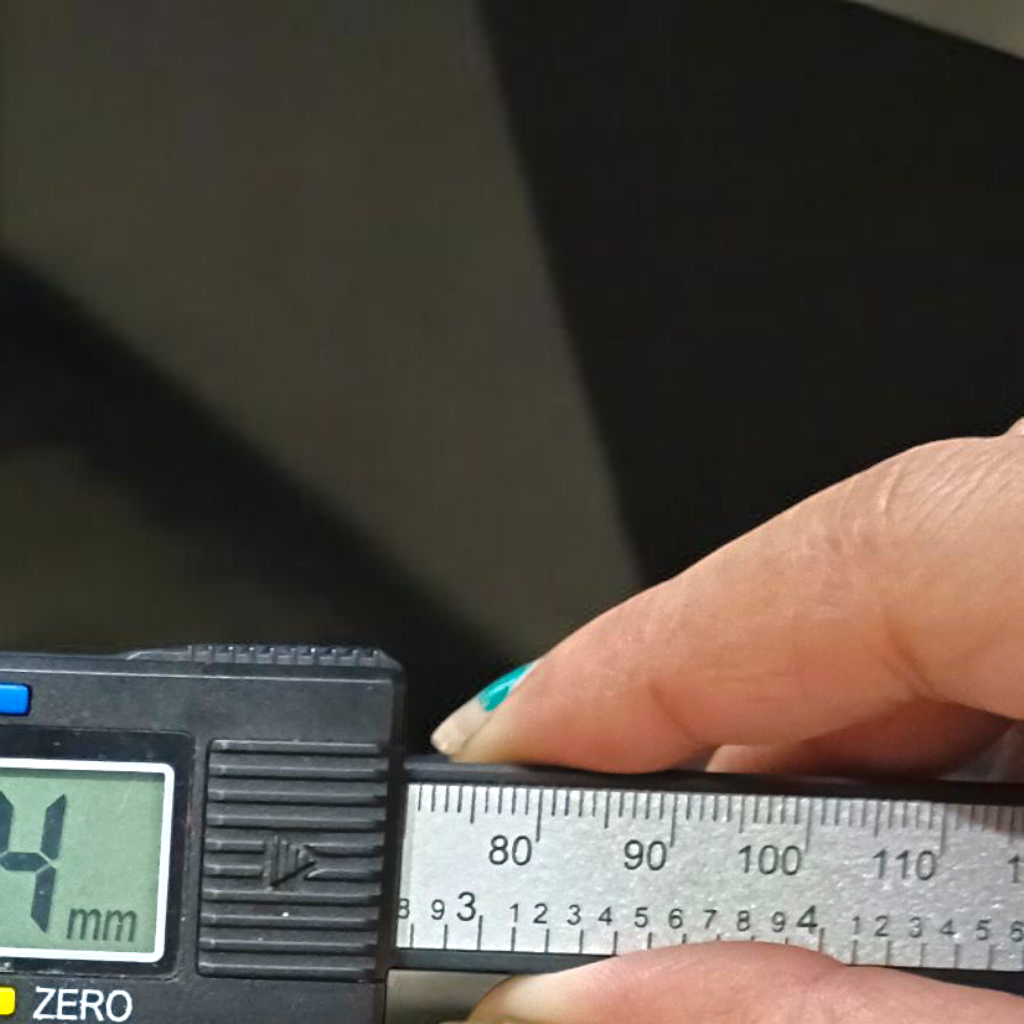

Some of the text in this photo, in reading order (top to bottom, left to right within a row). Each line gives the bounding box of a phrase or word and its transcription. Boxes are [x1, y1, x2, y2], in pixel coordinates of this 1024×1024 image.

[488, 834, 533, 866] 80
[623, 839, 668, 871] 90
[738, 844, 803, 876] 100
[873, 849, 938, 881] 110
[66, 907, 138, 943] mm
[430, 898, 446, 921] 9
[456, 891, 477, 922] 3
[509, 902, 520, 923] 1
[533, 902, 549, 924] 2
[566, 903, 582, 925] 3
[597, 905, 613, 924] 4
[634, 906, 649, 928] 5
[667, 907, 684, 929] 6
[703, 909, 718, 930] 7
[736, 910, 751, 932] 8
[770, 911, 786, 933] 9
[796, 904, 818, 934] 4
[851, 915, 862, 936] 1
[874, 915, 890, 937] 2
[908, 916, 923, 938] 3
[939, 919, 955, 938] 4
[975, 918, 991, 941] 5
[32, 985, 134, 1024] ZERO
